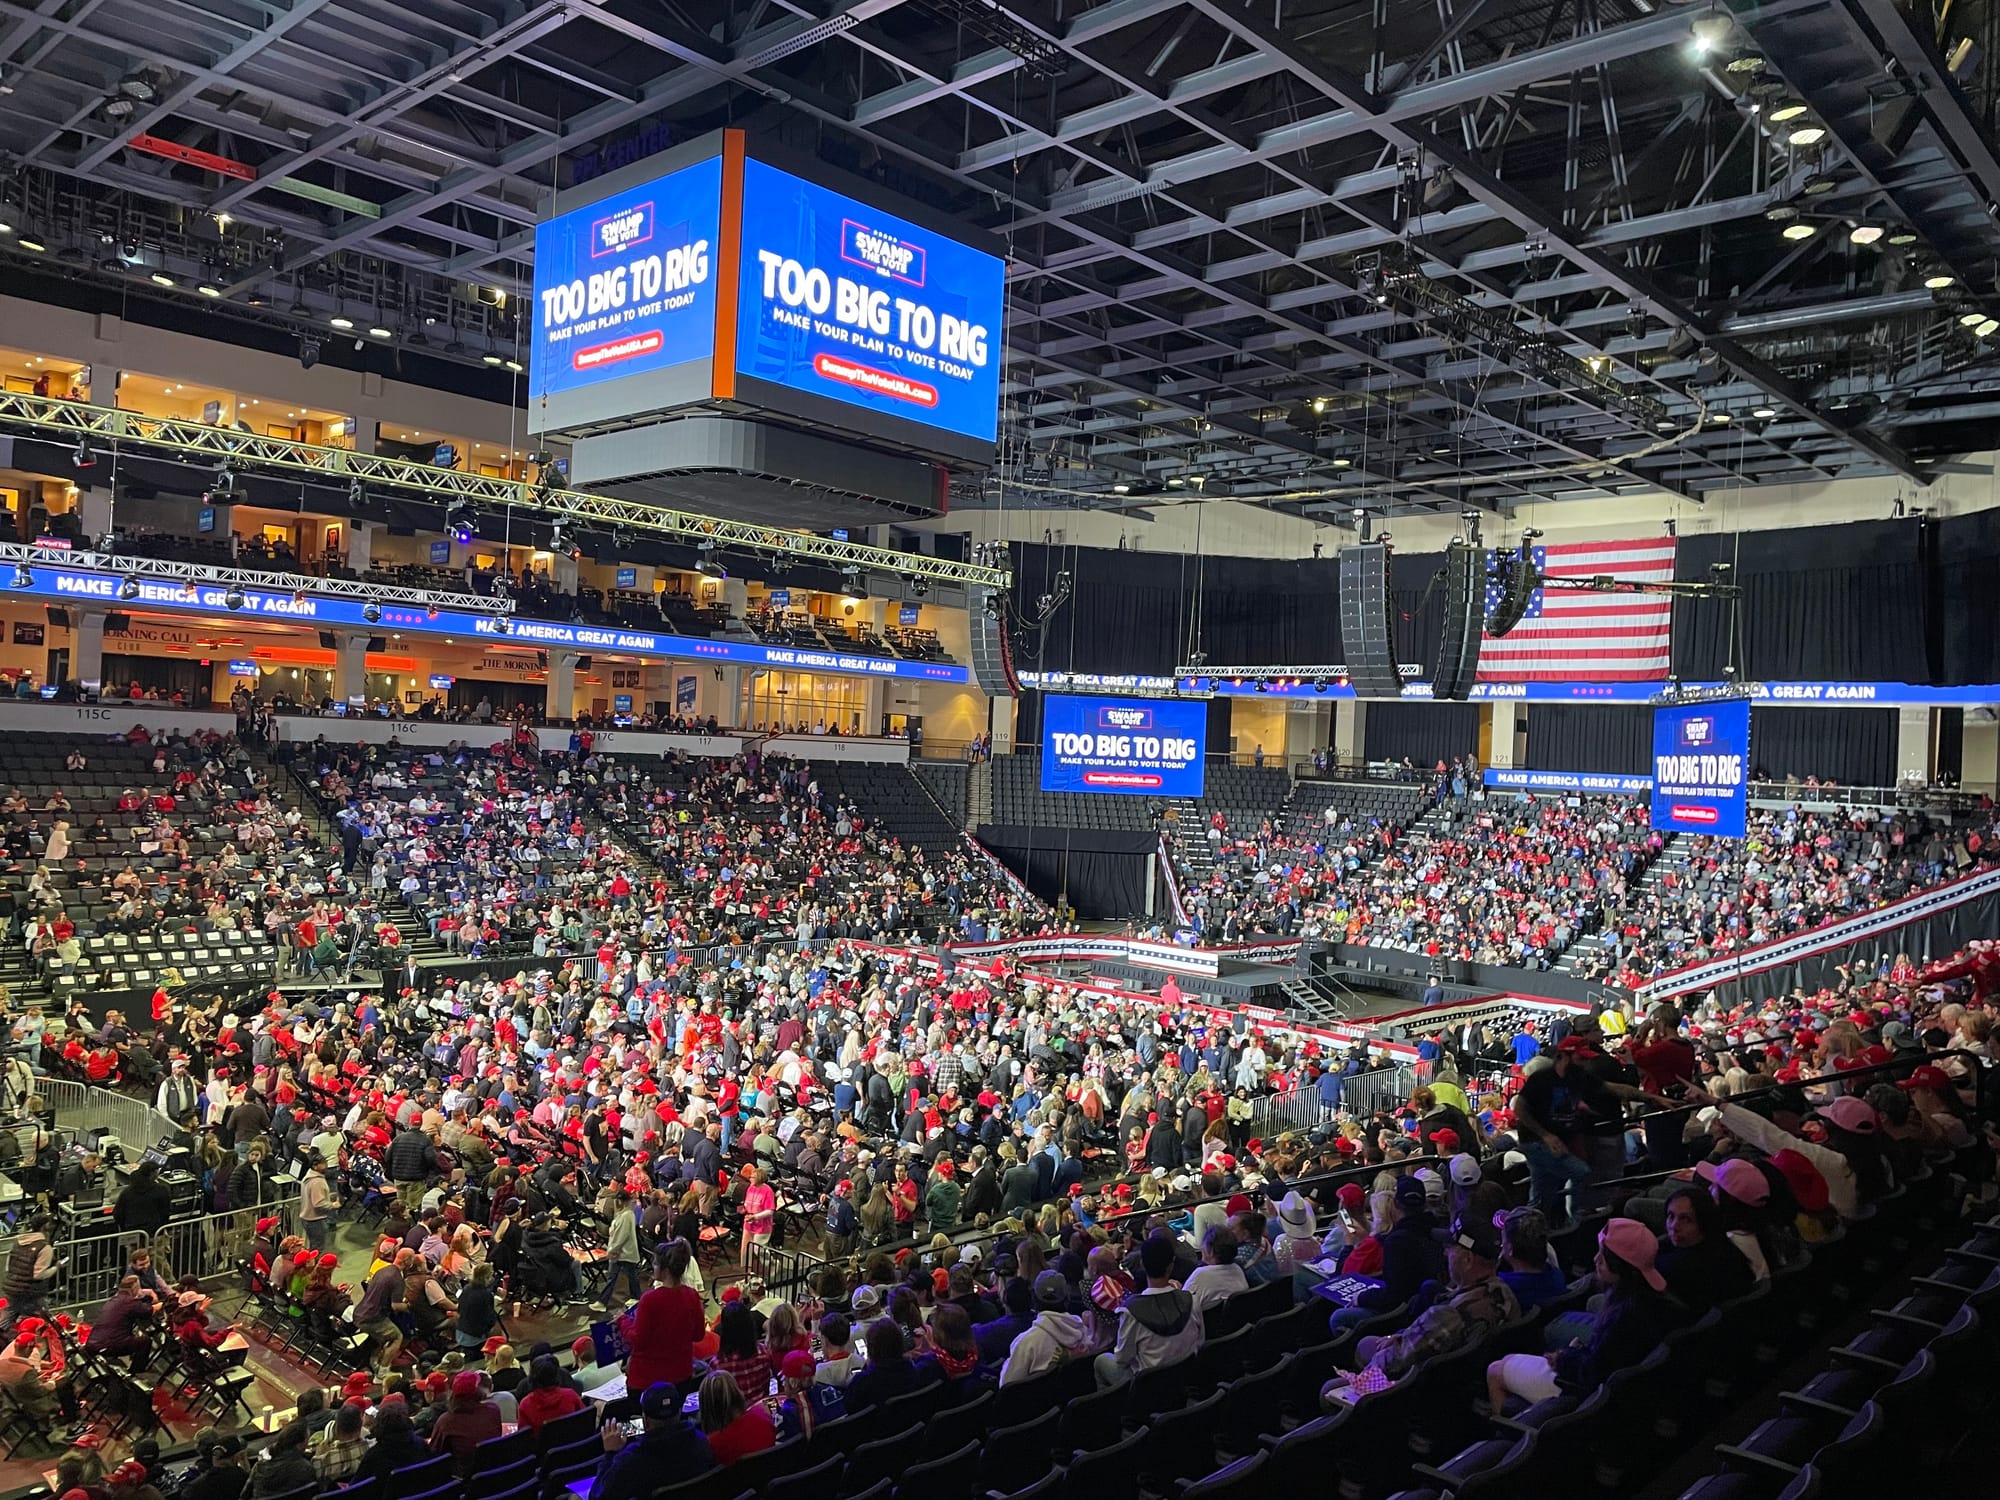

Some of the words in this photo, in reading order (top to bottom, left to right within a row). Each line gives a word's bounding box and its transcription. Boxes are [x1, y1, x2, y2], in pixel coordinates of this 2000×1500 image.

[601, 212, 644, 240] SWAMP
[620, 228, 640, 242] VOTE
[856, 231, 913, 262] SWAMP
[861, 250, 882, 264] THE
[883, 256, 907, 274] VOTE
[542, 280, 585, 327] TOO
[588, 266, 627, 315] BIG
[630, 255, 662, 301] TO
[665, 239, 709, 292] RIG
[549, 327, 572, 343] MAKE
[574, 321, 597, 335] YOUR
[598, 313, 621, 329] PLAN
[623, 309, 635, 321] TO
[638, 302, 662, 317] VOTE
[664, 291, 695, 310] TODAY
[758, 249, 831, 314] TOO
[836, 277, 890, 335] BIG
[896, 298, 935, 348] TO
[939, 314, 987, 366] RIG
[773, 307, 810, 330] MAKE
[814, 320, 848, 342] YOUR
[852, 333, 884, 353] PLAN
[887, 345, 903, 359] TO
[906, 352, 935, 369] VOTE
[938, 360, 974, 381] TODAY
[57, 576, 112, 595] MAKE
[203, 592, 257, 610] GRAT
[263, 598, 316, 616] AGAIN
[103, 629, 157, 641] ORNING
[161, 632, 194, 644] CALL
[475, 619, 515, 634] MAE
[516, 624, 574, 641] AMERICA
[576, 629, 618, 645] GREAT
[617, 635, 655, 649] AGAIN
[482, 659, 501, 668] THE
[504, 660, 543, 671] MORNIN
[766, 650, 795, 661] MAKE
[796, 653, 838, 667] AMERICA
[839, 658, 868, 669] GREAT
[869, 662, 897, 673] AGAIN
[1101, 675, 1138, 687] GREAT
[1139, 677, 1174, 688] AGAIN
[1489, 685, 1526, 696] AGAIN
[1778, 686, 1821, 698] GREAT
[1825, 685, 1875, 698] AGAIN
[77, 709, 111, 720] 115C
[1107, 711, 1144, 720] SWAMP
[391, 723, 417, 733] 116C
[1052, 733, 1094, 756] TOO
[1096, 734, 1130, 757] BIG
[1133, 736, 1160, 759] TO
[1162, 738, 1196, 760] RIG
[1060, 757, 1082, 765] MAKE
[1084, 758, 1105, 766] YOUR
[1106, 759, 1126, 767] PLAN
[1140, 760, 1160, 768] VOTE
[1162, 761, 1186, 769] TODAY
[1657, 755, 1679, 783] TOO
[1679, 755, 1699, 784] BIG
[1700, 755, 1717, 784] TO
[1717, 755, 1741, 785] RIG
[1497, 773, 1527, 784] MAKE
[1530, 774, 1579, 786] AMERICA
[1582, 777, 1620, 789] GREAT
[1902, 770, 1922, 779] 122
